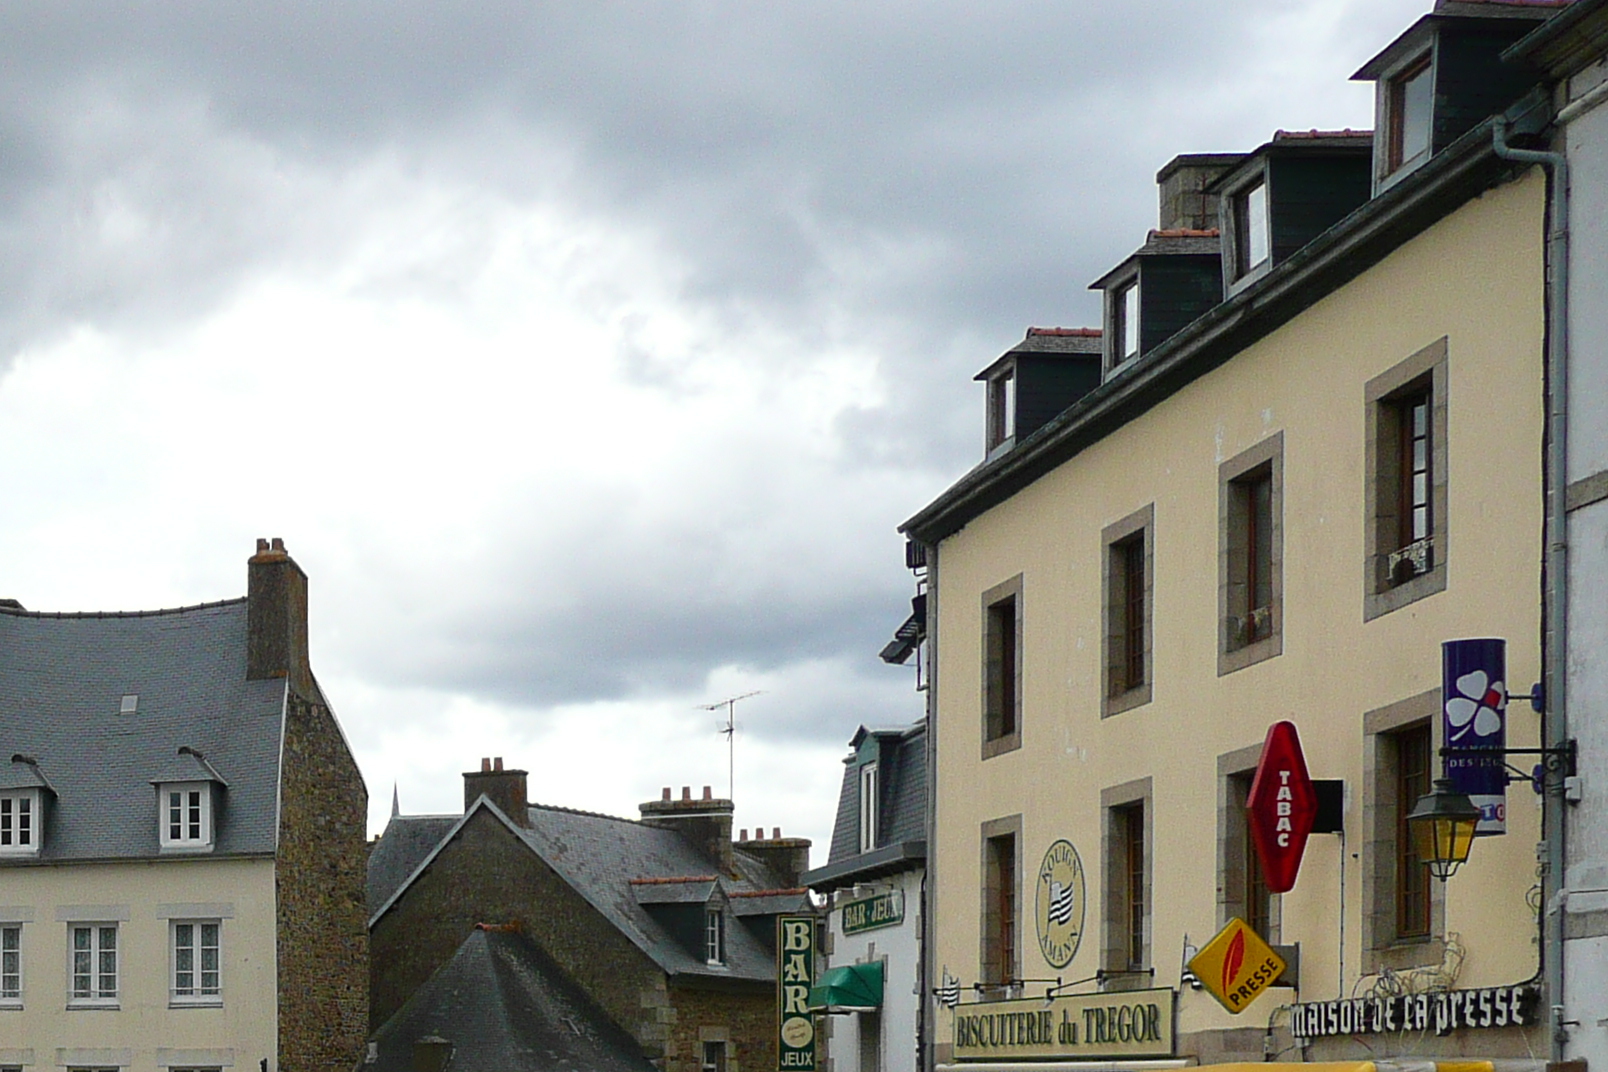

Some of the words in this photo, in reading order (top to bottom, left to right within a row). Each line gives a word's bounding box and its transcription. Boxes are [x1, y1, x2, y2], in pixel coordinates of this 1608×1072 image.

[1276, 770, 1293, 848] TABAC
[845, 904, 866, 929] BAR
[871, 895, 899, 923] JEUX
[784, 922, 810, 1014] BAR
[1228, 957, 1279, 1007] PRESSE
[956, 1010, 1052, 1048] BISCUITERIE
[1058, 1009, 1077, 1045] du
[1082, 1003, 1161, 1043] TREGOR
[781, 1051, 813, 1066] JEUX
